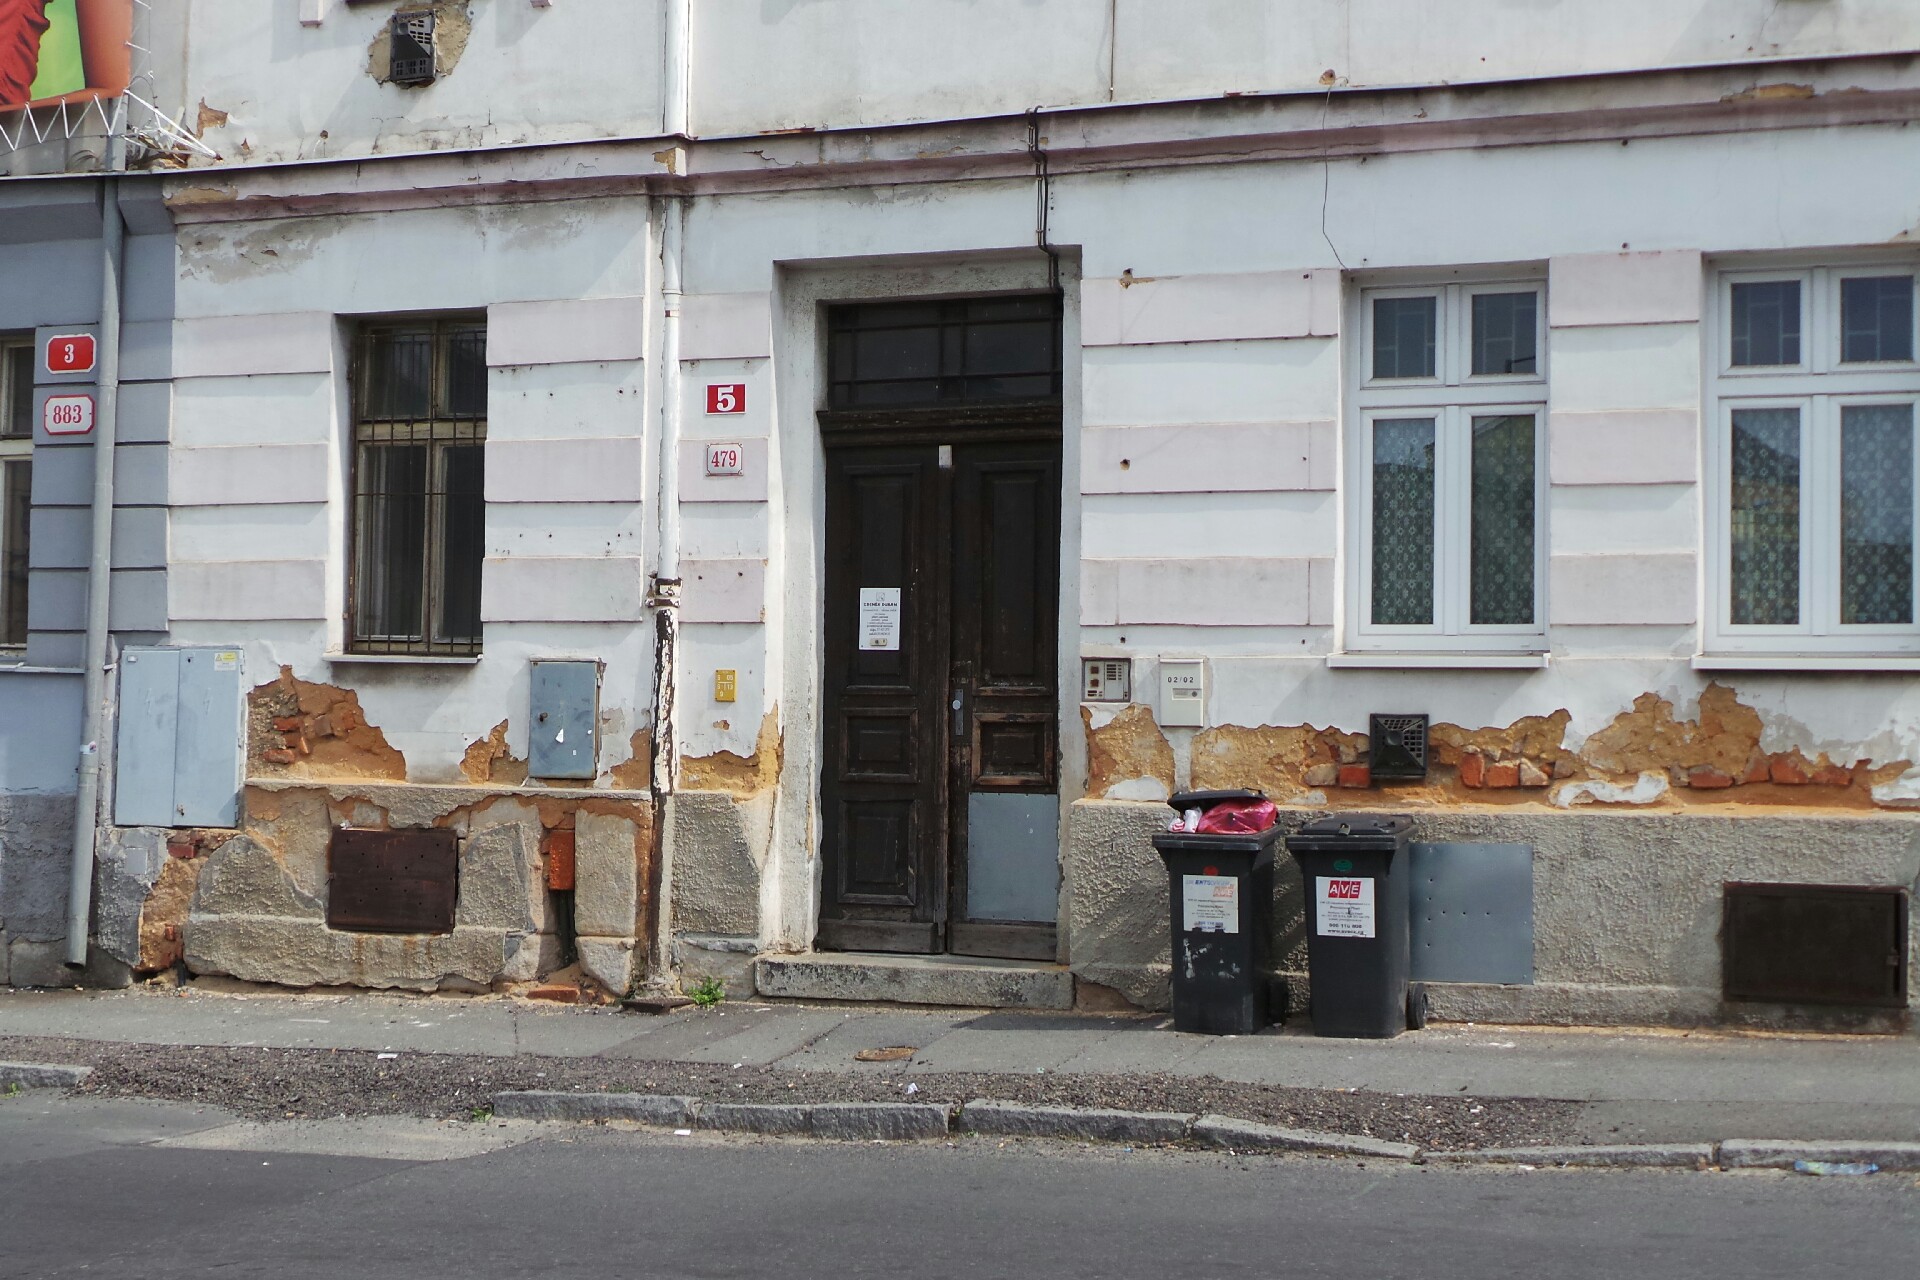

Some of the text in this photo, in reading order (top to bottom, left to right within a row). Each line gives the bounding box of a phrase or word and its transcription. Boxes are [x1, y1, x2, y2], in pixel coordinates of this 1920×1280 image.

[64, 343, 75, 364] 3
[716, 385, 736, 412] 5
[53, 404, 82, 424] 883
[711, 450, 737, 468] 479
[1167, 676, 1194, 684] 02/02
[1329, 884, 1360, 895] AVE
